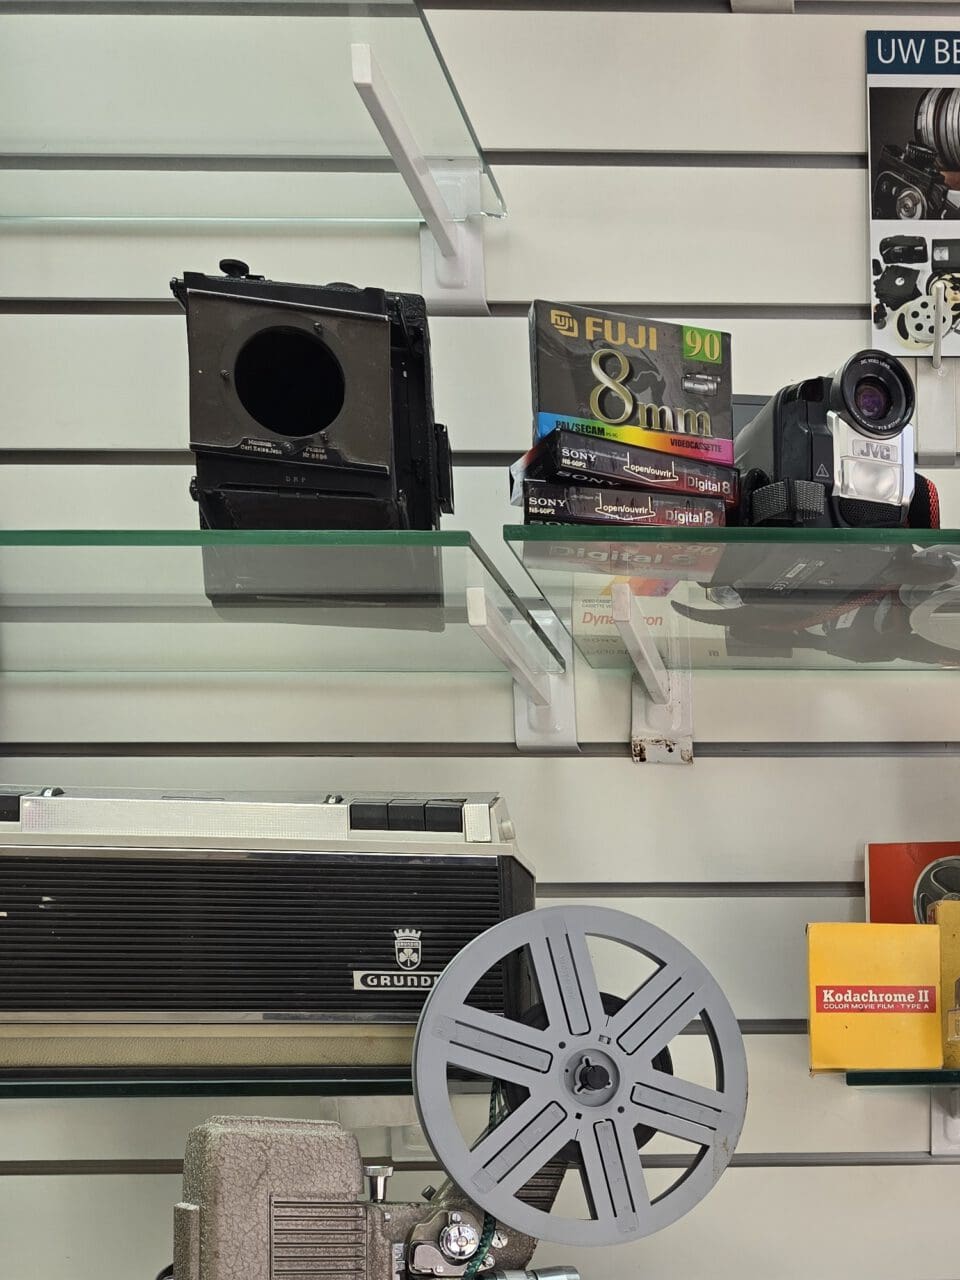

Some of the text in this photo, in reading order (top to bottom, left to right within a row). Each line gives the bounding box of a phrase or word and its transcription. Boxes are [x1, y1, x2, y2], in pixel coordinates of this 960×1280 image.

[875, 38, 926, 65] UW
[585, 316, 721, 361] FUJI 90
[555, 420, 606, 437] PAL/SECAM
[669, 437, 722, 453] VIDEOCASSETTE
[860, 442, 891, 460] JVC
[561, 448, 597, 462] SONY
[629, 464, 673, 478] open/ouvrir
[686, 475, 731, 495] Digital 8
[528, 496, 567, 508] SONY
[602, 504, 649, 515] open/ouvrir
[665, 510, 713, 524] Digital 8
[822, 989, 930, 1003] Kodachrome II
